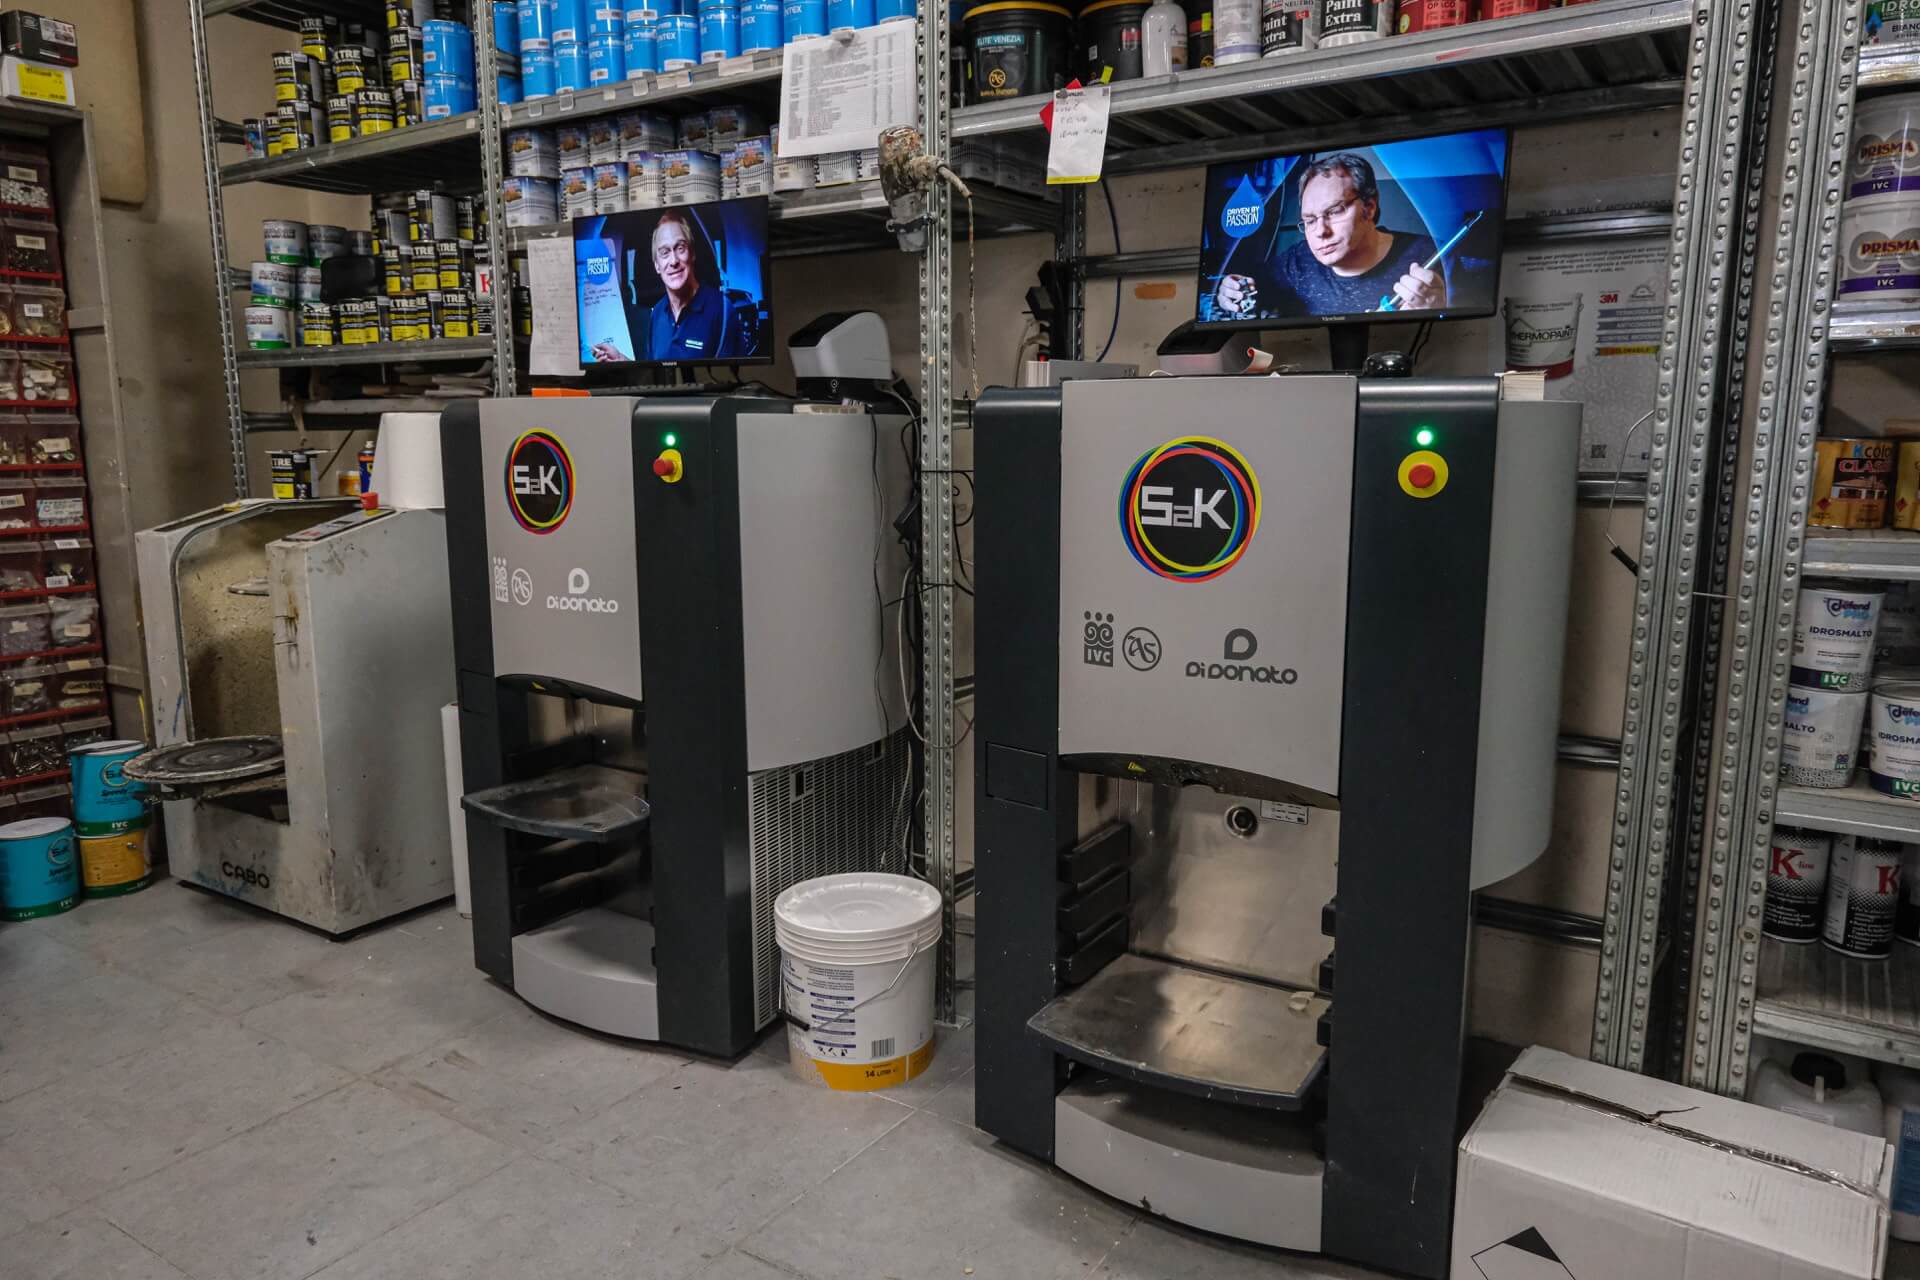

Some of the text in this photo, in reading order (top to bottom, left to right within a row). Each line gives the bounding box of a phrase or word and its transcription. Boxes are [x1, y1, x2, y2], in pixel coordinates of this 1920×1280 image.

[1325, 12, 1361, 27] Extra
[993, 34, 1022, 44] VENEZIA
[1264, 31, 1286, 44] xtra
[358, 91, 391, 102] K TRE
[1860, 141, 1914, 159] PRISMA
[1872, 182, 1889, 191] IVC
[1227, 206, 1260, 215] DRIVEN BY
[1226, 213, 1259, 228] PASSION
[1861, 240, 1920, 257] PRISMA
[1877, 278, 1895, 287] IVC
[446, 293, 466, 303] TRE
[1600, 294, 1618, 304] 3M
[273, 457, 293, 466] TRE
[1809, 626, 1873, 638] IDROSMALTO
[1087, 648, 1112, 664] IVC
[1824, 674, 1848, 684] IVC
[1895, 781, 1920, 793] IVC
[222, 861, 270, 889] CABO
